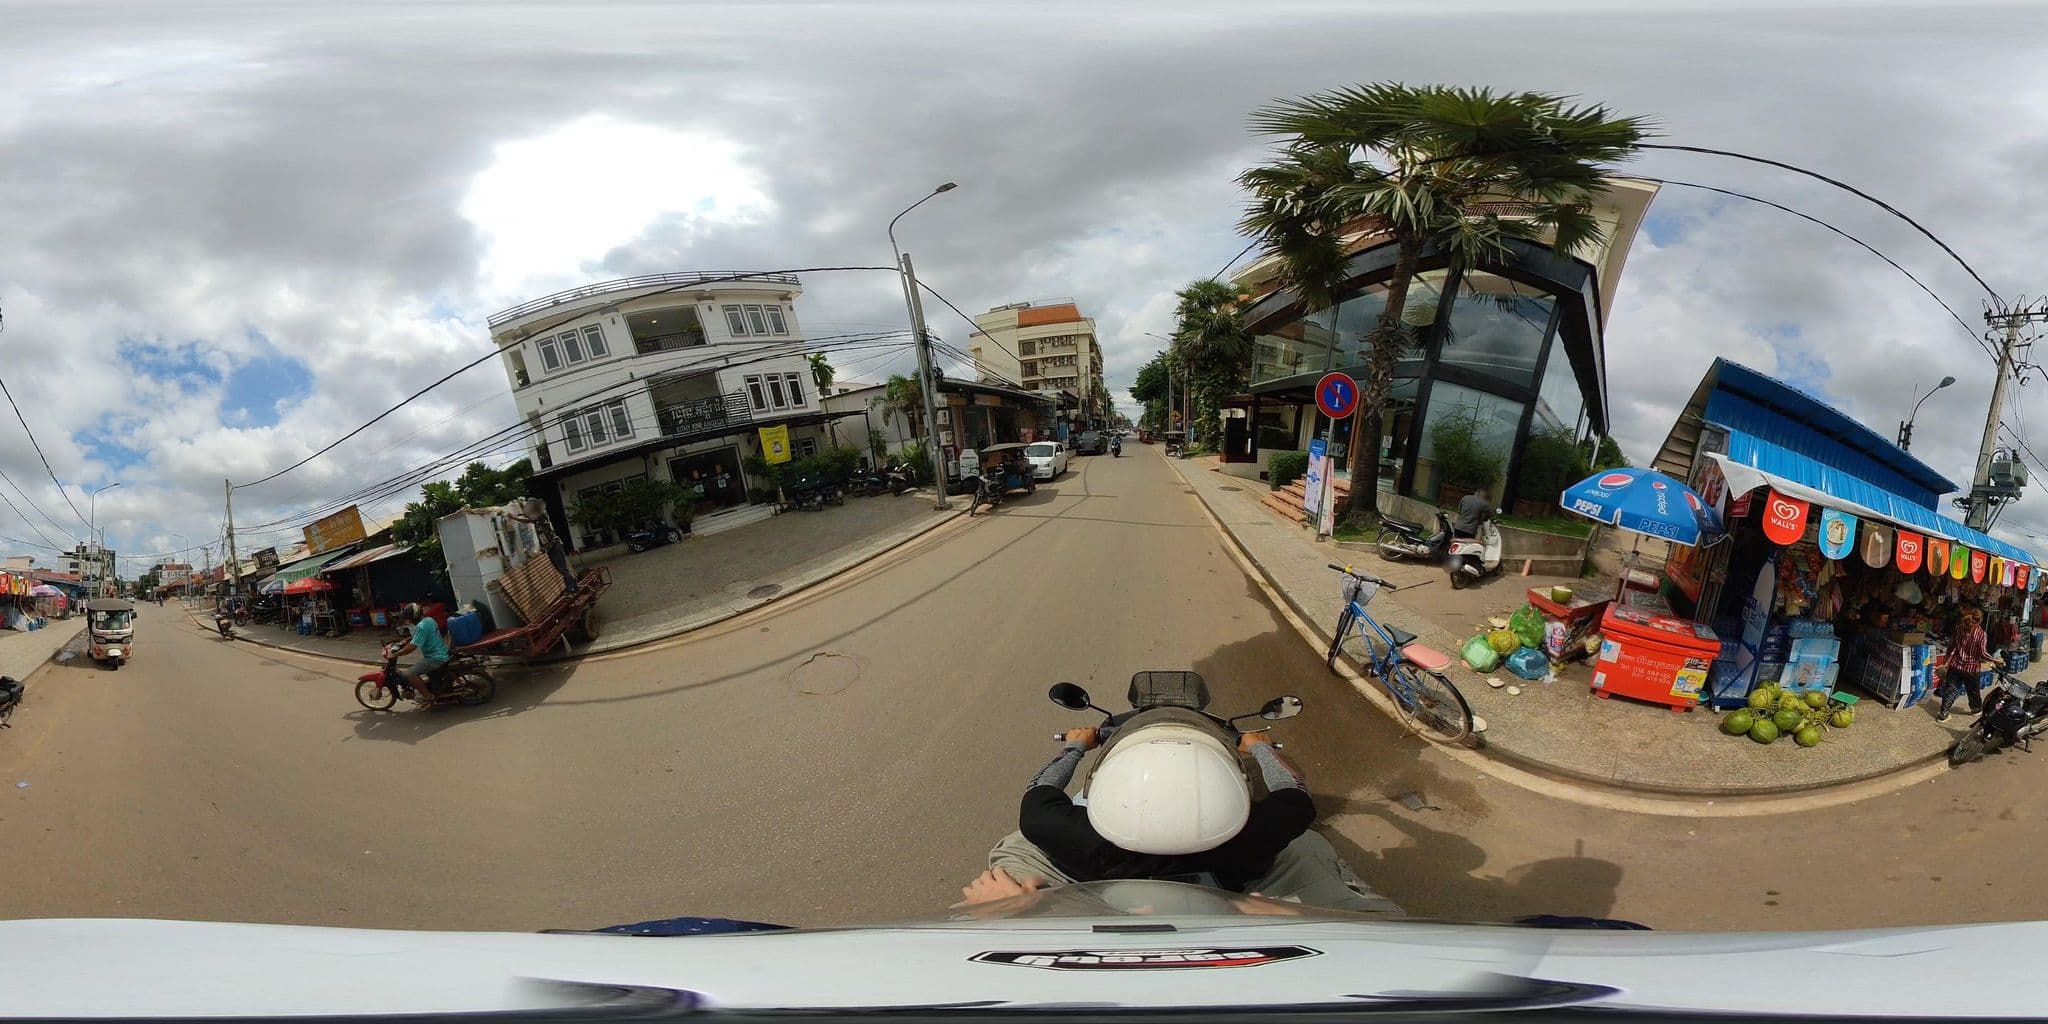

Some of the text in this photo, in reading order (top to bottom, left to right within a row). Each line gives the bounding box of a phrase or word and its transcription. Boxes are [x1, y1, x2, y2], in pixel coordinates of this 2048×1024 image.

[1585, 489, 1611, 498] pepsi
[1574, 499, 1602, 517] PEPSI
[1657, 491, 1669, 515] pepsi
[1639, 518, 1680, 538] PEPSI
[1770, 516, 1797, 531] WALL'S
